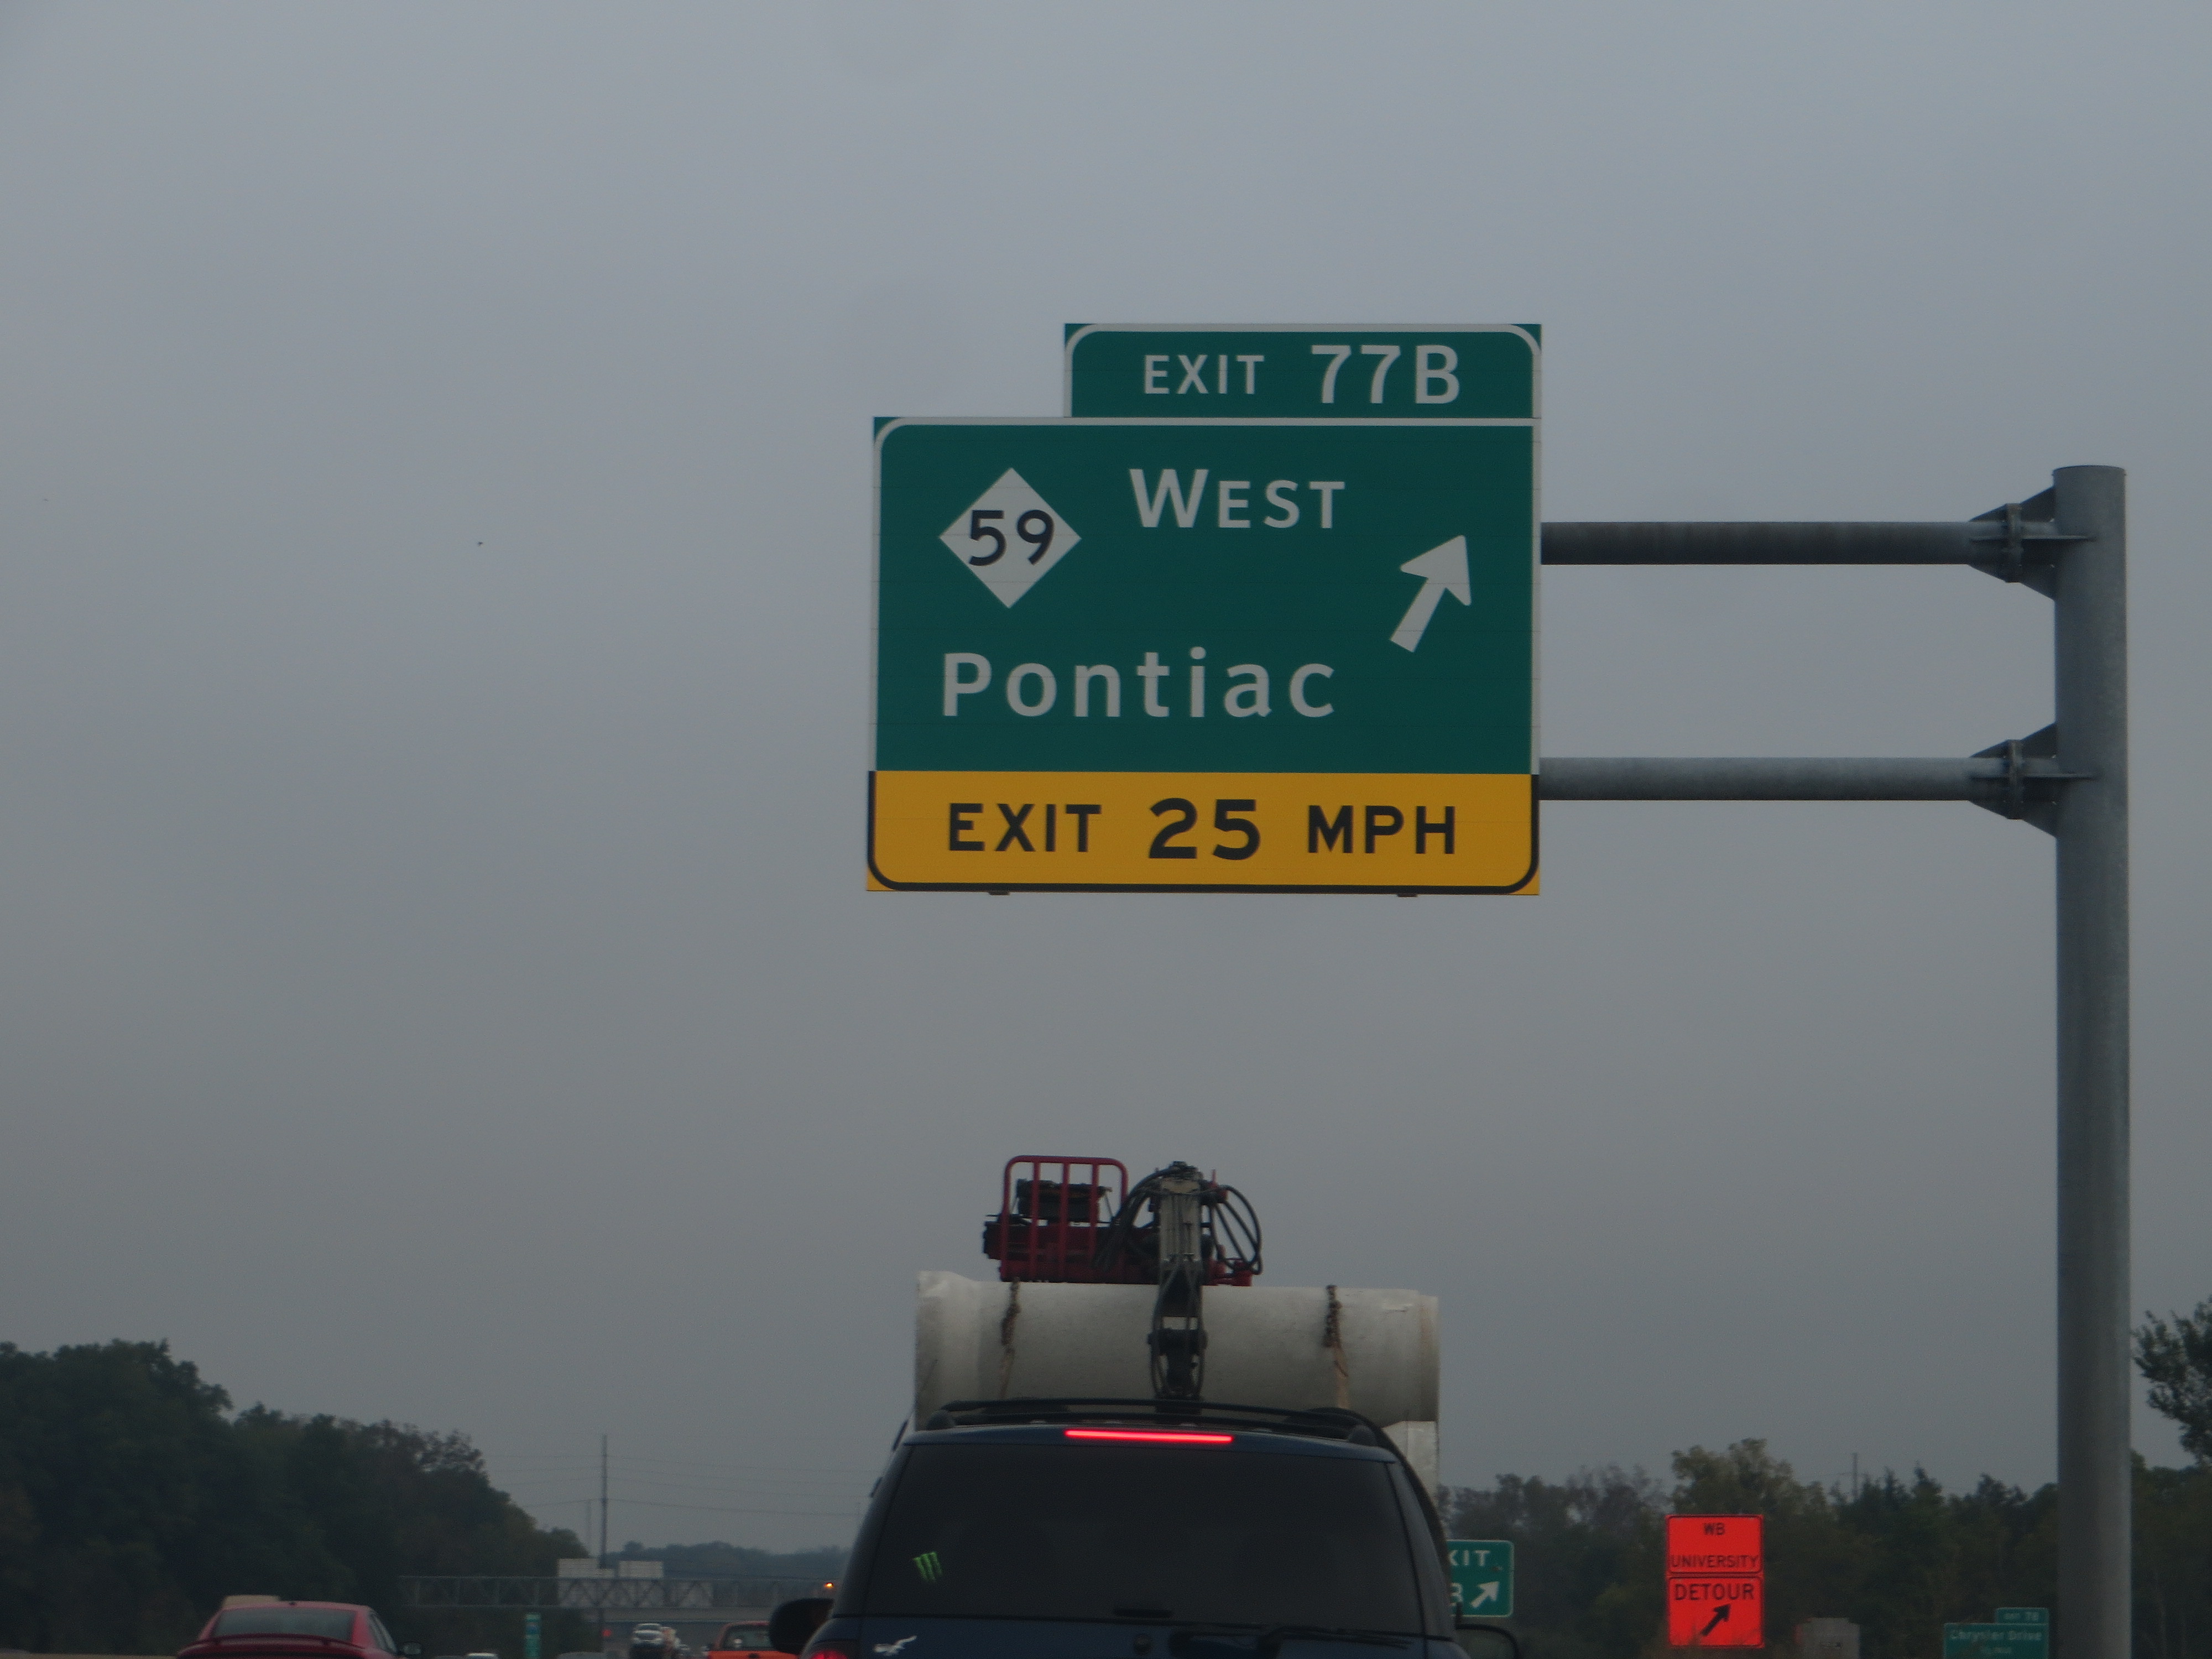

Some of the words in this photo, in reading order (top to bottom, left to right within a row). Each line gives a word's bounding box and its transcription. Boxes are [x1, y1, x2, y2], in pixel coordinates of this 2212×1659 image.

[1145, 354, 1264, 394] EXIT
[1312, 345, 1459, 404] 77B
[1130, 469, 1344, 528] WEST
[967, 509, 1055, 566] 59
[943, 646, 1333, 717] Pontiac
[949, 803, 1100, 852] EXIT
[1149, 798, 1260, 860] 25
[1308, 805, 1454, 854] MPH
[1703, 1522, 1725, 1535] WB
[1447, 1550, 1491, 1566] XIT
[1671, 1554, 1759, 1567] UNIVERSITY
[1674, 1583, 1755, 1600] DETOUR
